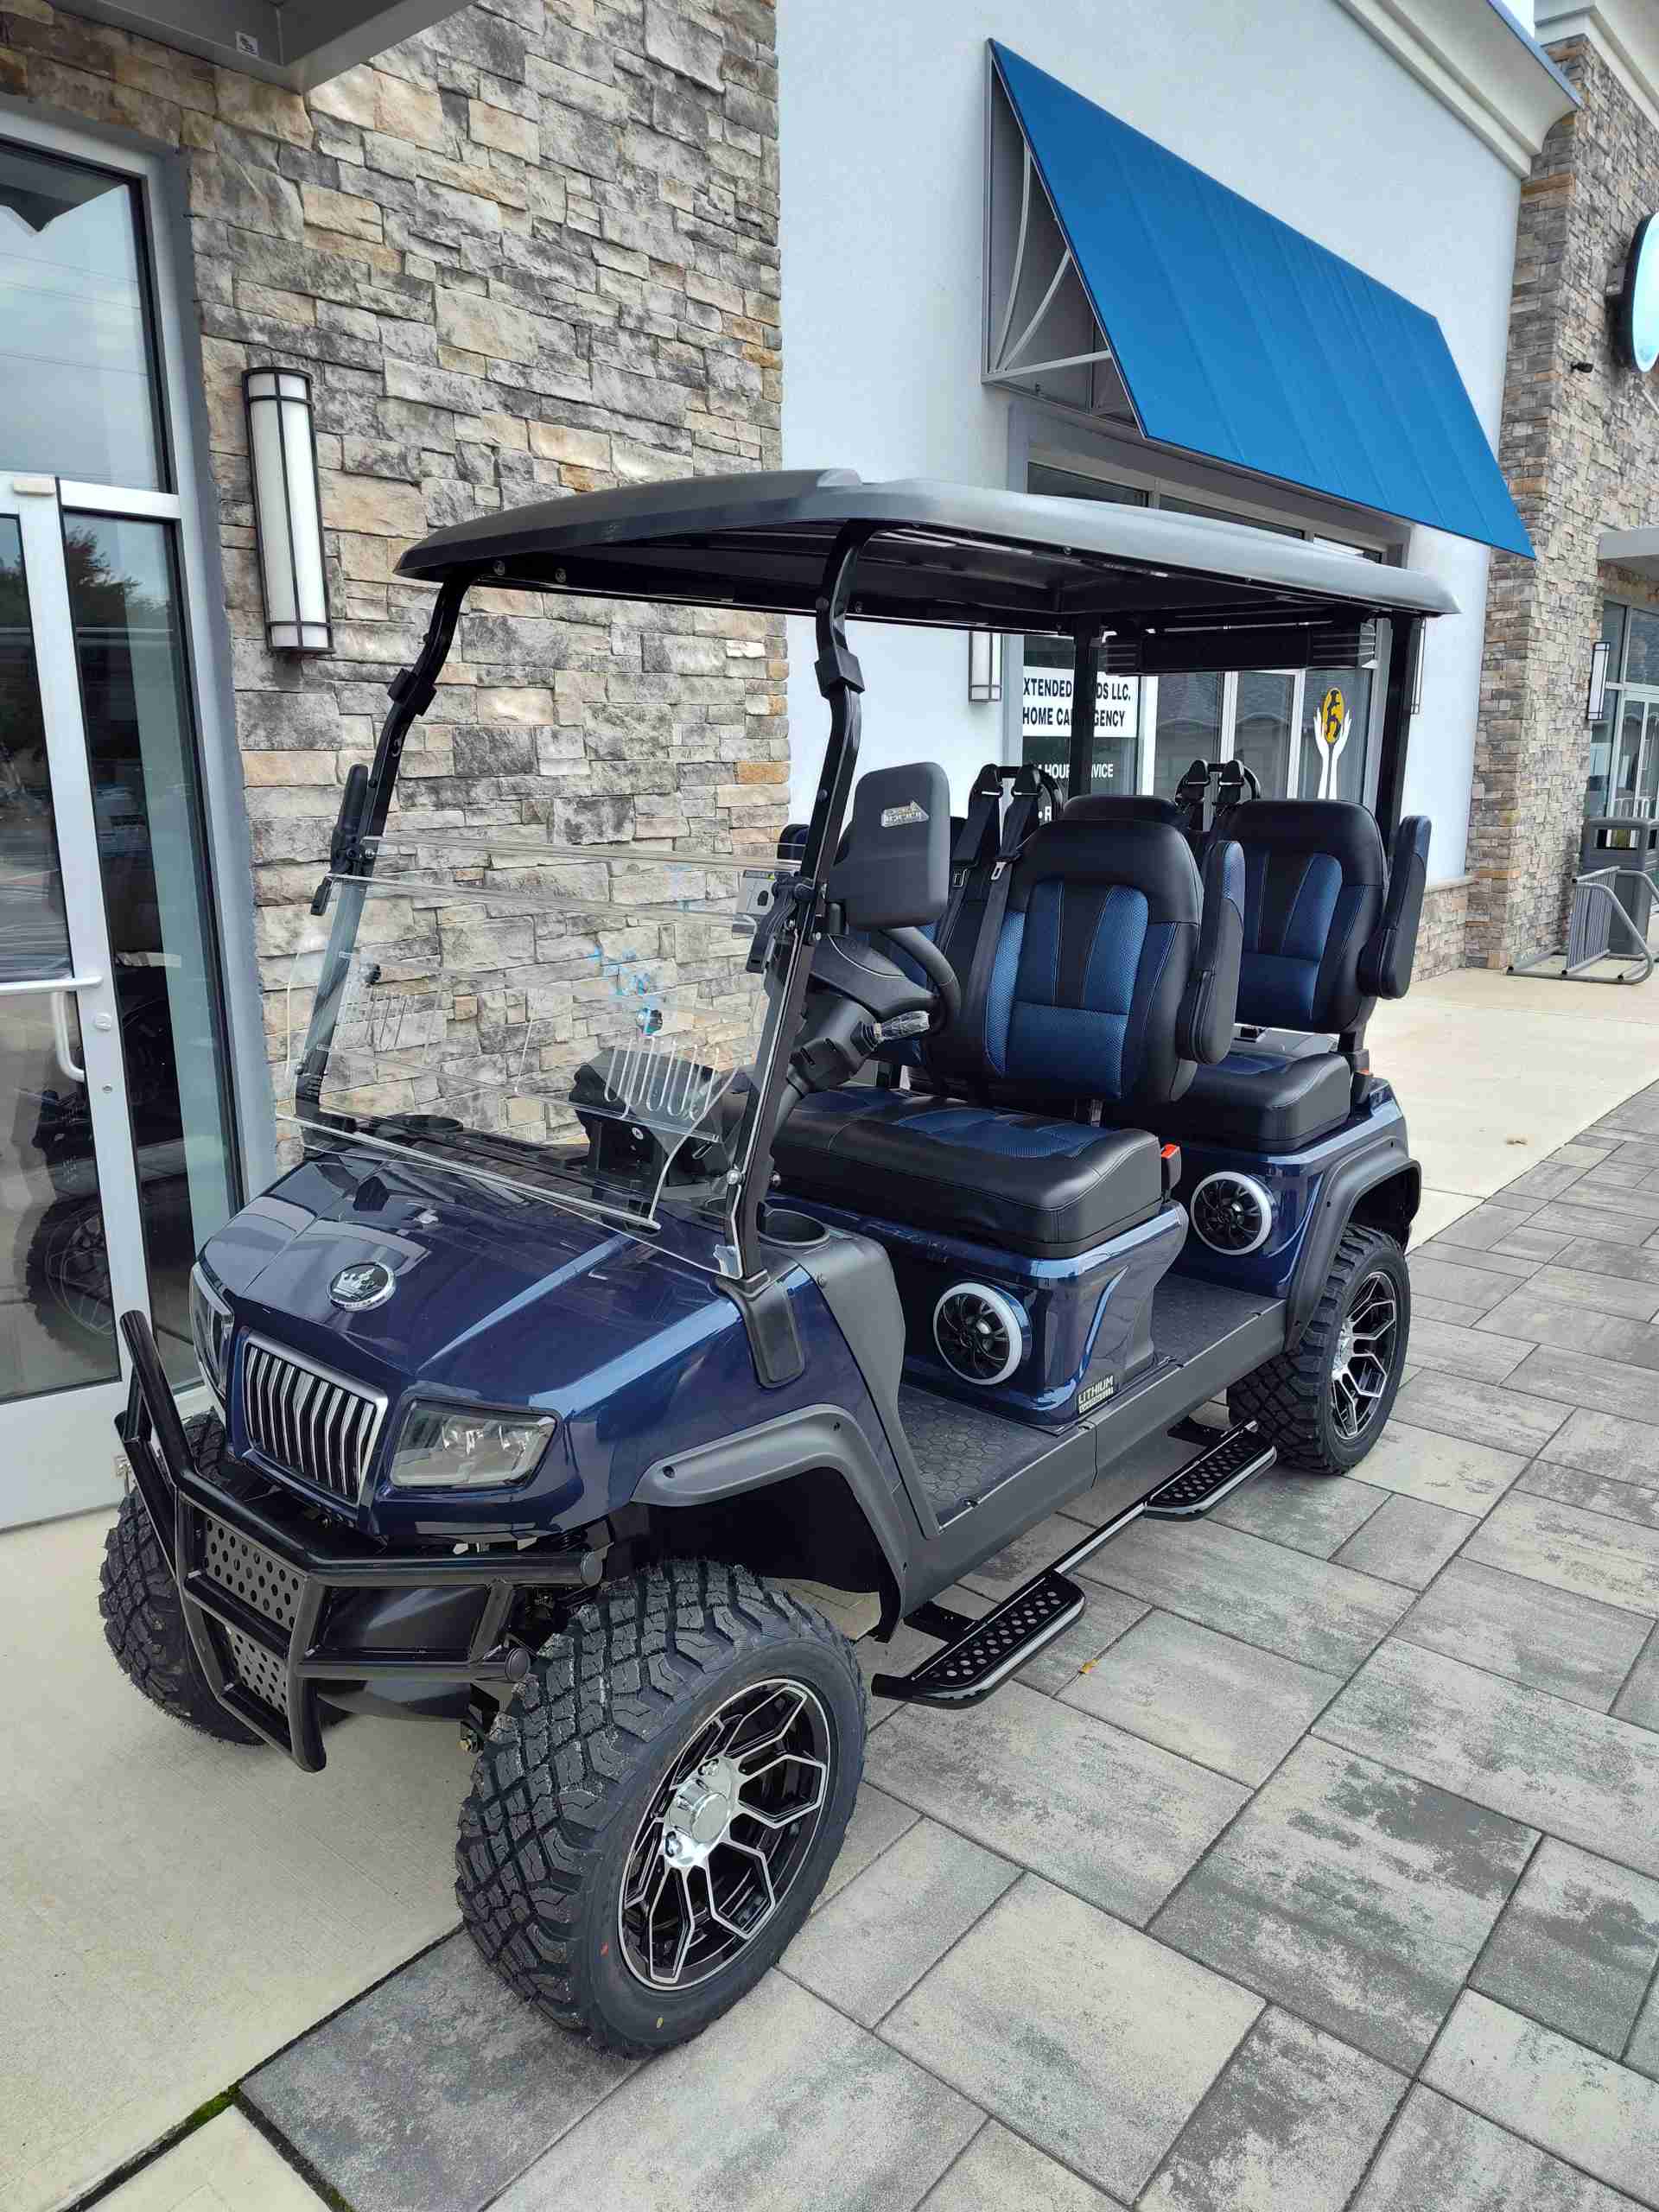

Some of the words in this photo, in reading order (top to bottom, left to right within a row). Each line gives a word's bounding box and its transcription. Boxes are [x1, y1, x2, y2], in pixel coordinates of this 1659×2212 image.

[1023, 677, 1072, 698] XTENDED
[1111, 683, 1131, 701] LLC.
[1022, 707, 1053, 726] HOME
[1056, 708, 1072, 726] CA
[1093, 709, 1125, 727] GENCY
[1090, 764, 1114, 778] VICE
[1078, 1375, 1114, 1405] LITHIUM
